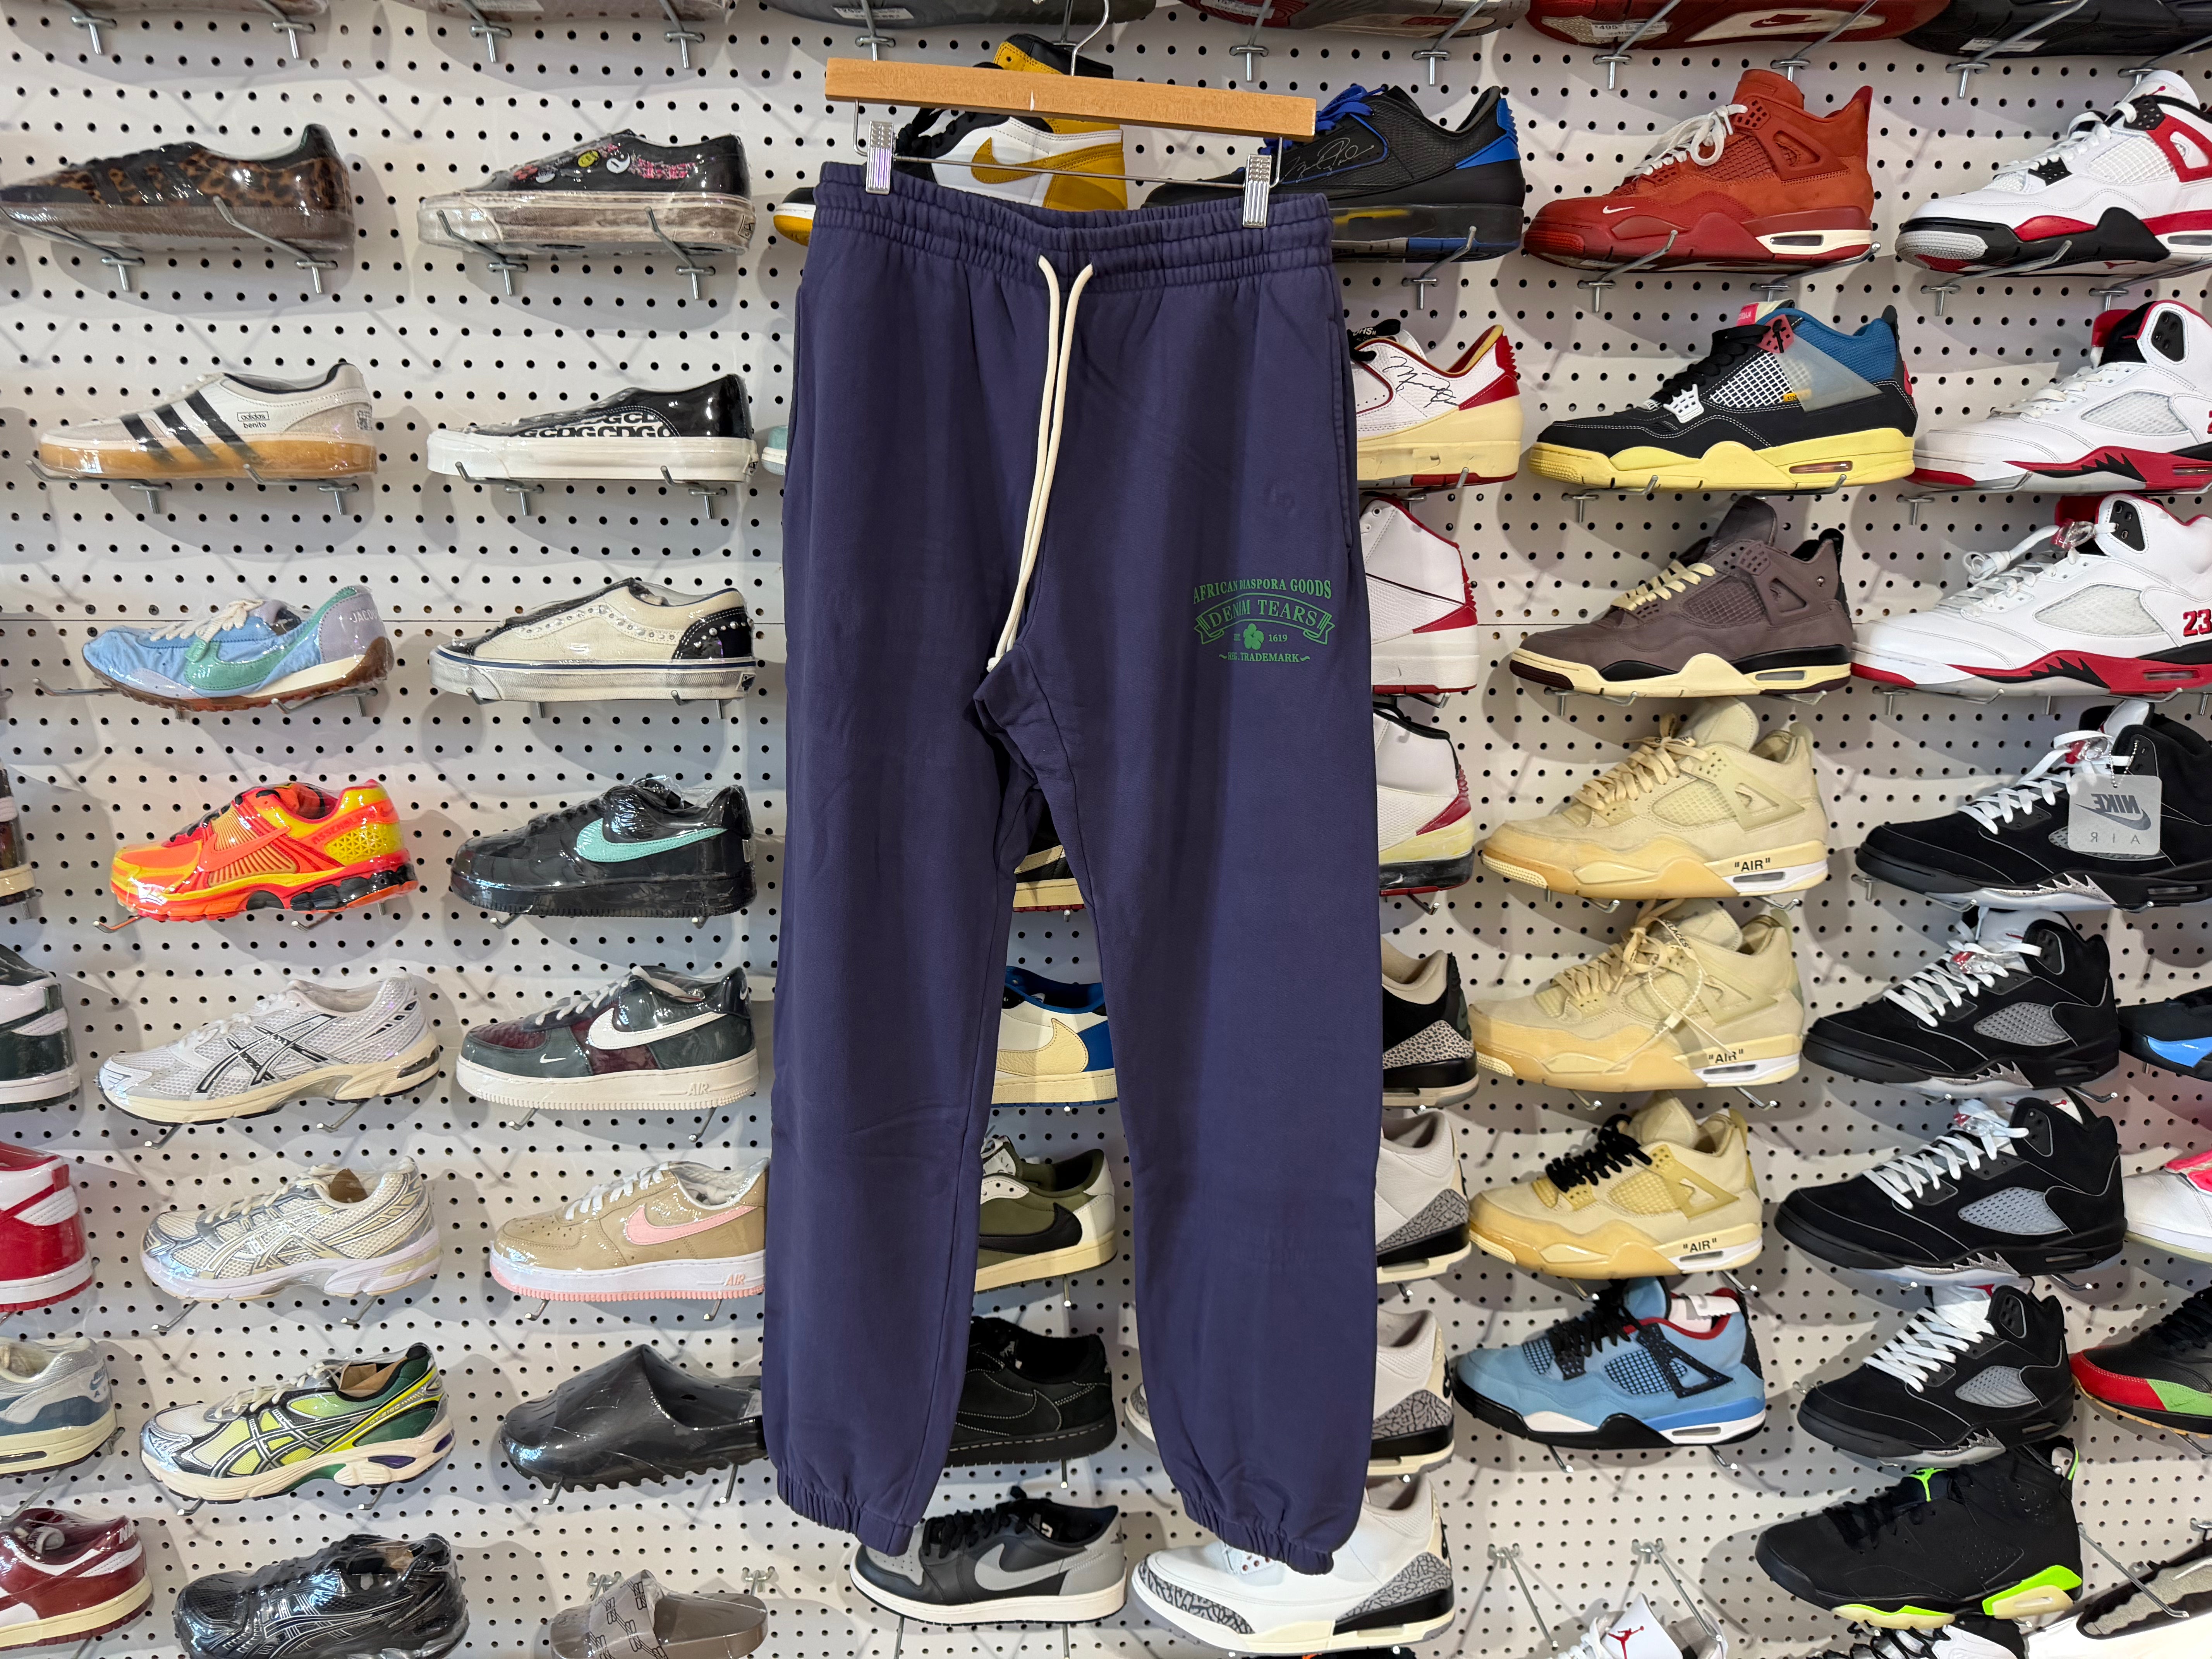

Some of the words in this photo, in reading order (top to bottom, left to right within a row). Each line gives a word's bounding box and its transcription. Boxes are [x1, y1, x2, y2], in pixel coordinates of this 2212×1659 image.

[240, 411, 266, 421] adidas
[1193, 580, 1238, 604] AFRICAN
[1239, 579, 1286, 591] DIASPORA
[1290, 579, 1332, 599] GOODS
[1207, 599, 1250, 628] DENIM
[1257, 599, 1317, 627] TEARS
[2183, 608, 2212, 637] 23
[1268, 634, 1288, 642] 1619
[1240, 652, 1300, 663] TRADEMARK
[1734, 857, 1771, 872] "AIR"
[1708, 1048, 1744, 1064] "AIR"
[687, 1082, 709, 1096] AIR
[1683, 1237, 1717, 1253] "AIR"
[724, 1273, 745, 1286] AIR
